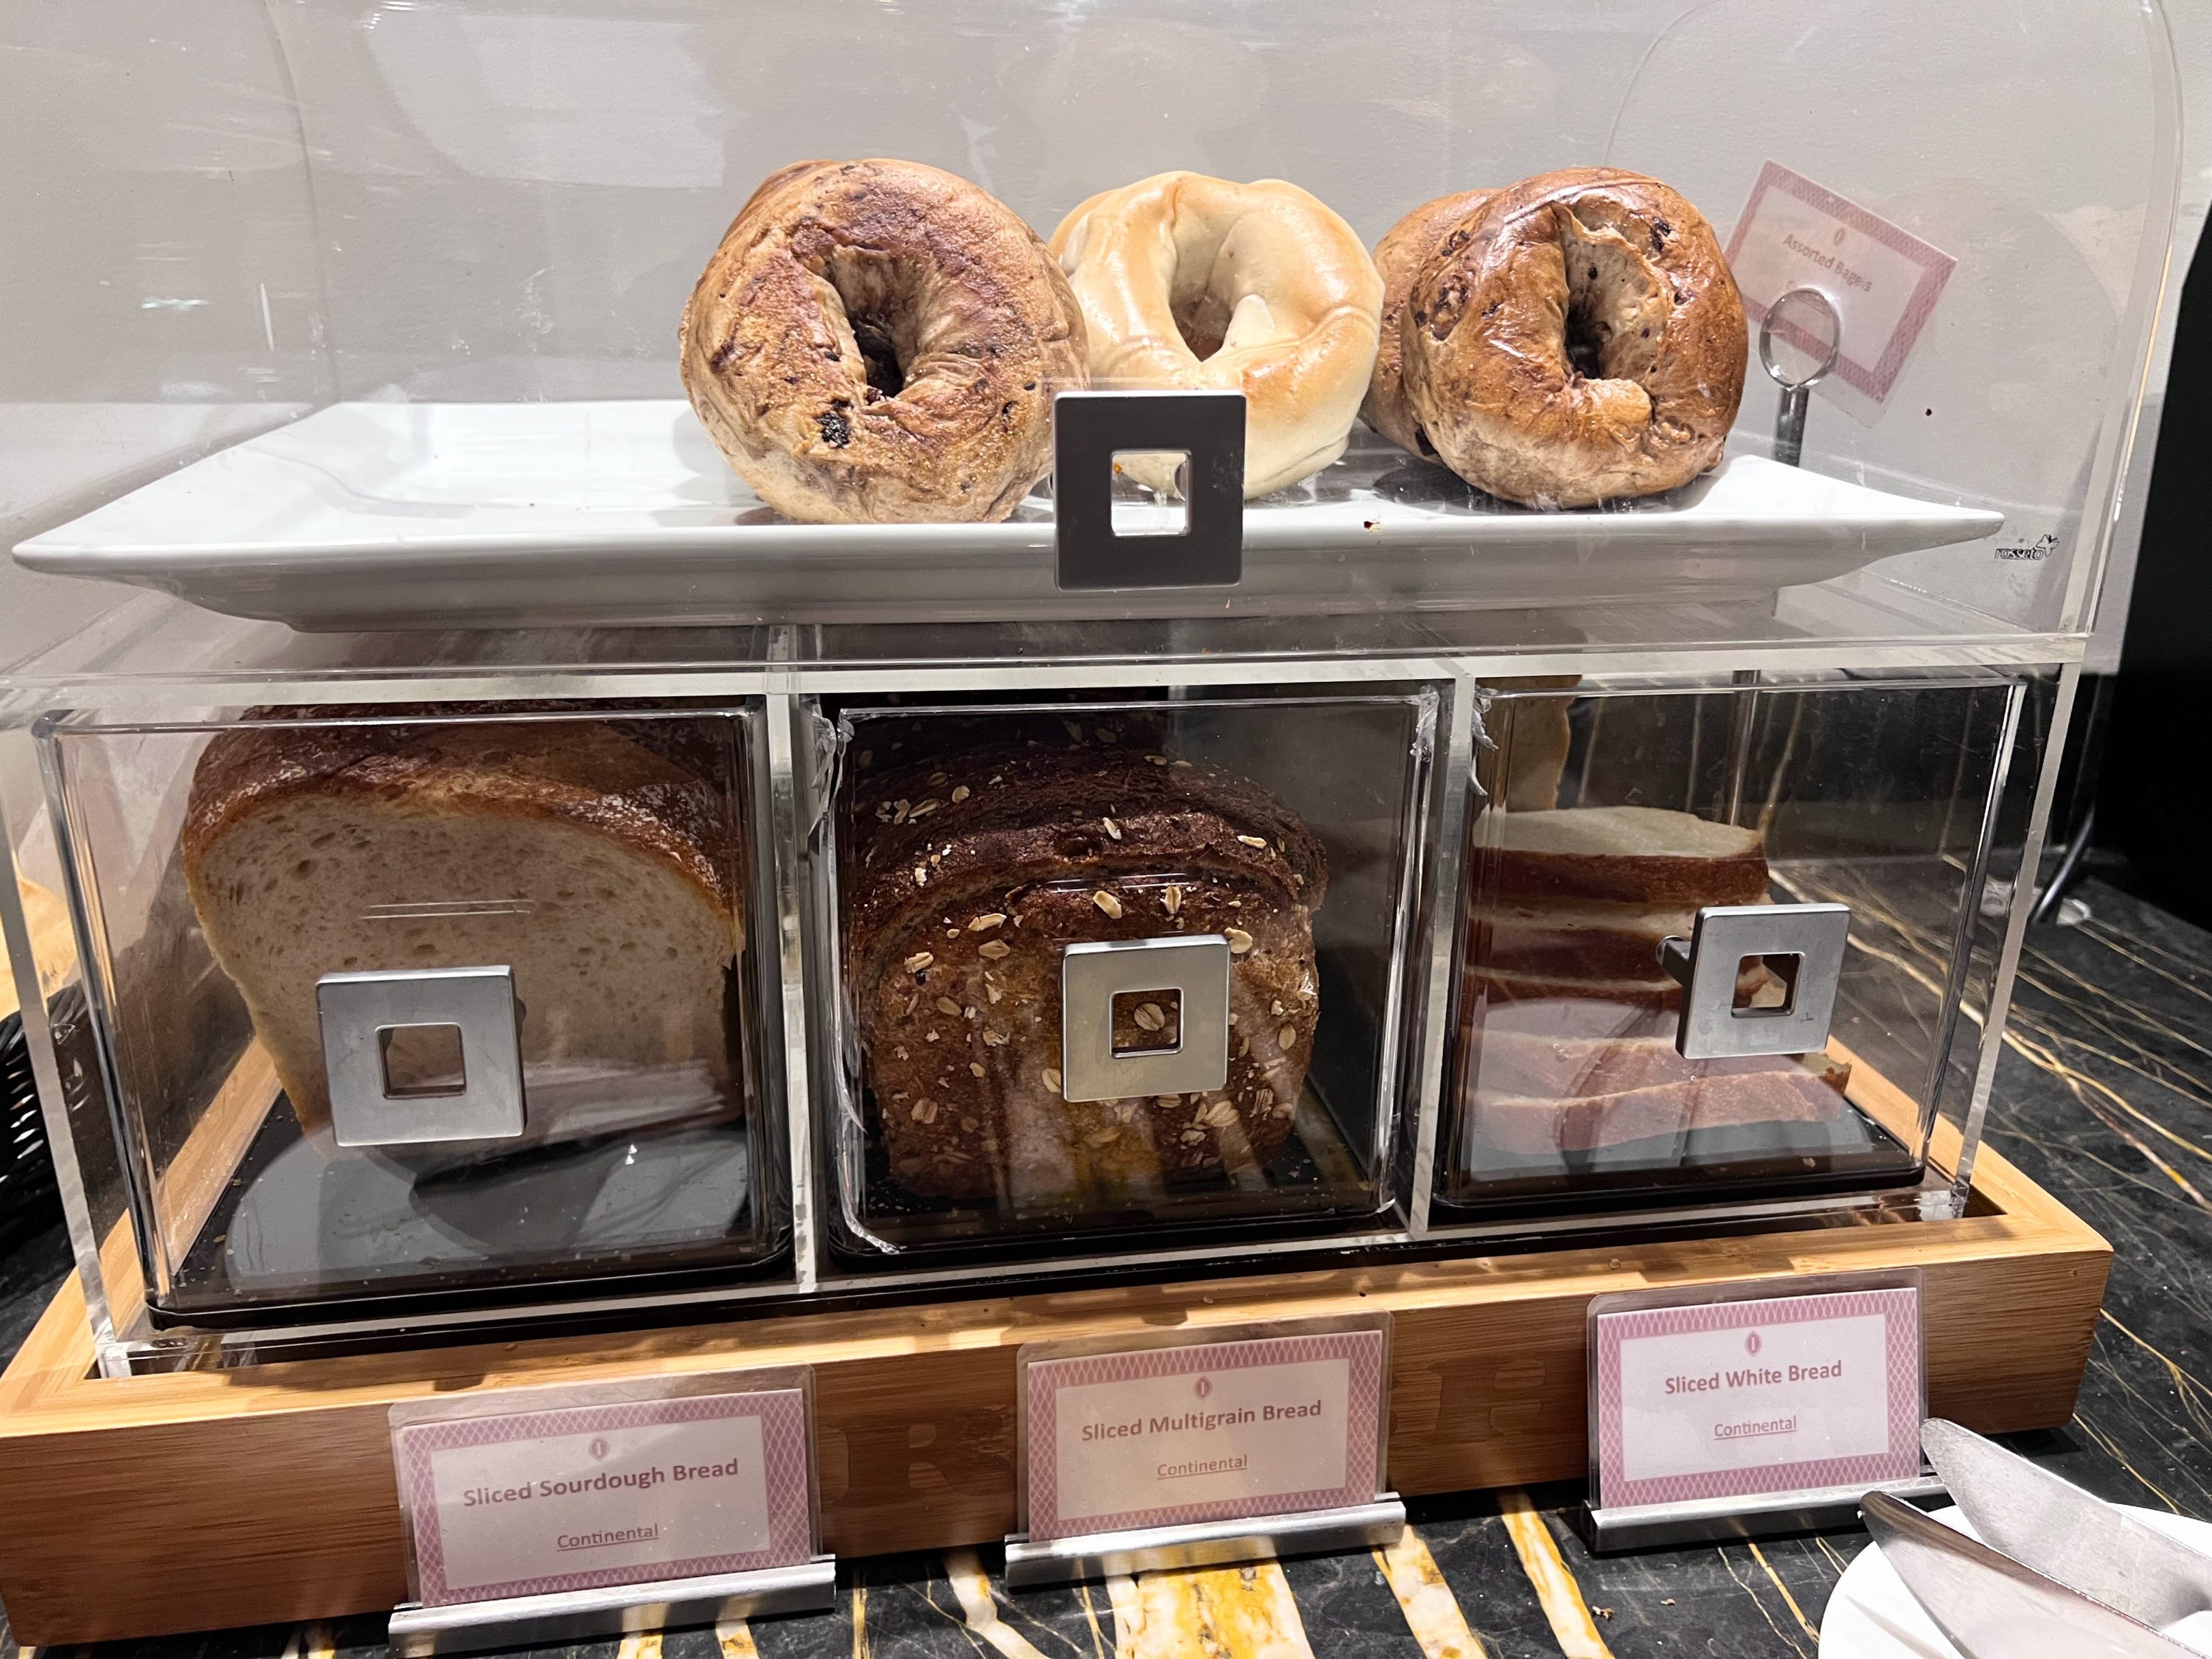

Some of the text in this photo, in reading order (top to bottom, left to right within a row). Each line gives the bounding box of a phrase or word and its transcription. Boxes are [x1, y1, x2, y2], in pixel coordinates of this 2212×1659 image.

[1783, 234, 1835, 268] Assorted
[1994, 547, 2044, 560] rosseto
[1665, 1360, 1842, 1394] Sliced White Bread
[1082, 1399, 1322, 1441] Sliced Multigrain Bread
[1714, 1416, 1798, 1439] Continental
[1157, 1455, 1248, 1478] Continental
[463, 1458, 739, 1507] Sliced Sourdough Bread
[557, 1523, 659, 1549] Continental
